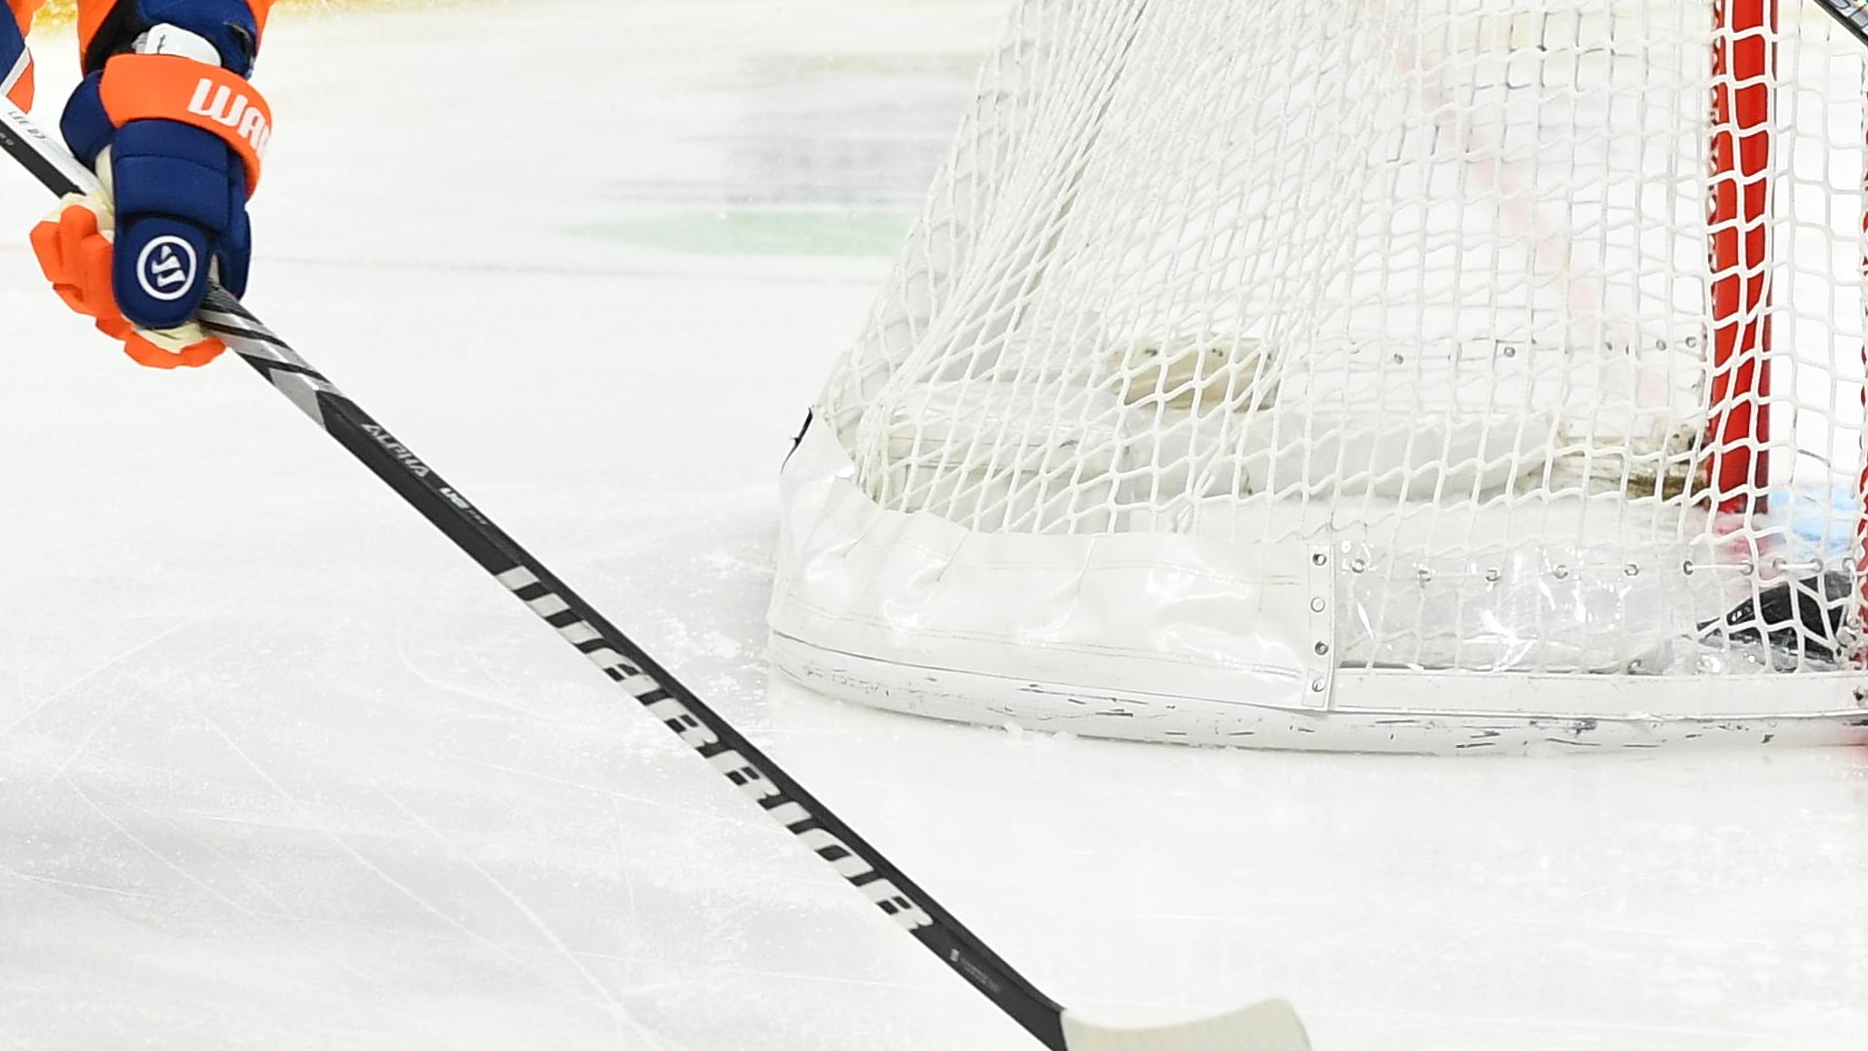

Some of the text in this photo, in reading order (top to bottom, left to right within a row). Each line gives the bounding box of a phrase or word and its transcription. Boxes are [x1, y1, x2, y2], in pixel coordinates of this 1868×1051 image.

[186, 77, 270, 154] WA
[361, 422, 430, 478] ALPHA
[494, 564, 934, 932] WARRIOR
